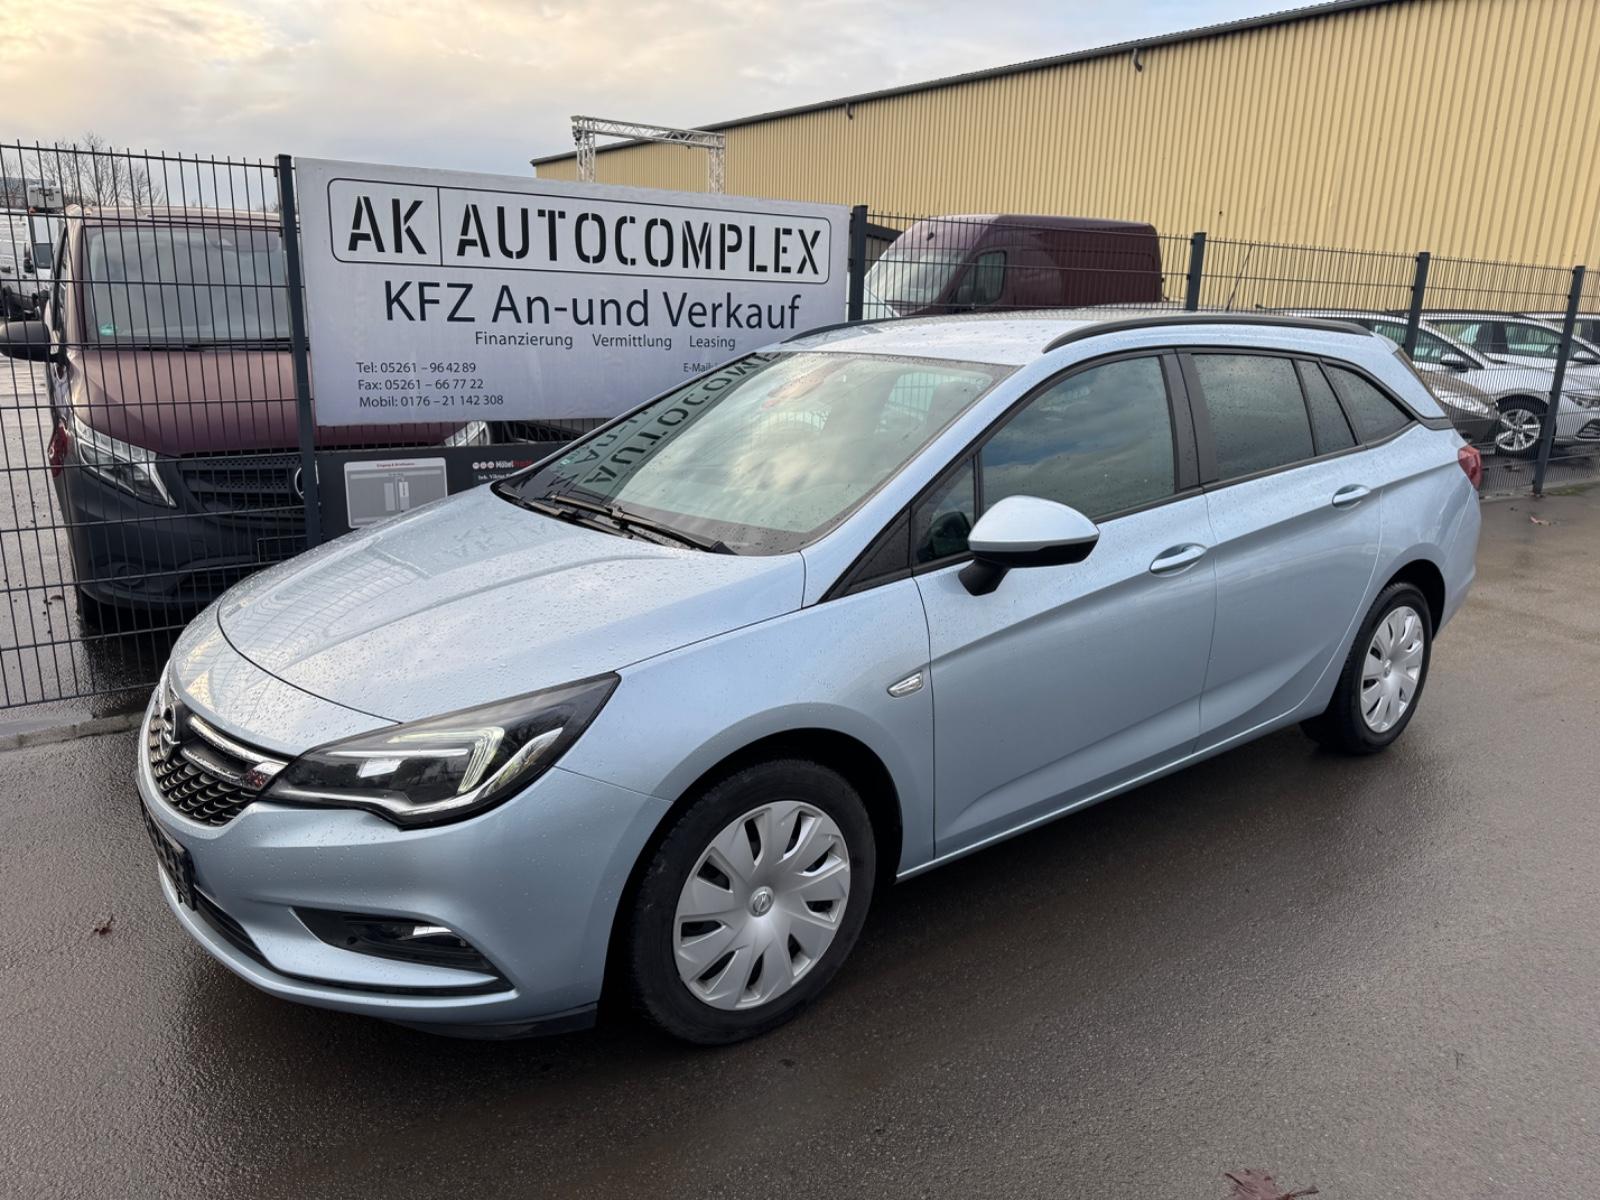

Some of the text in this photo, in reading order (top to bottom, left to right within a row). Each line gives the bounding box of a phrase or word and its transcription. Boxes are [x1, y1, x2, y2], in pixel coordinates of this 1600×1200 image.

[348, 195, 821, 275] AK AUTOCOMPLEX
[384, 280, 802, 329] KFZ An-und Verkauf
[475, 331, 736, 351] Finanzierung Vermittlung Leasing
[356, 362, 377, 373] Tel:
[380, 362, 417, 373] 05261
[357, 379, 382, 390] Fax:
[385, 379, 421, 390] 05261
[435, 379, 449, 390] 66
[453, 379, 466, 389] 77
[470, 379, 484, 389] 22
[359, 396, 398, 408] Mobil:
[400, 396, 430, 407] 0176
[442, 395, 455, 406] 21
[460, 395, 480, 406] 142
[483, 395, 504, 405] 308
